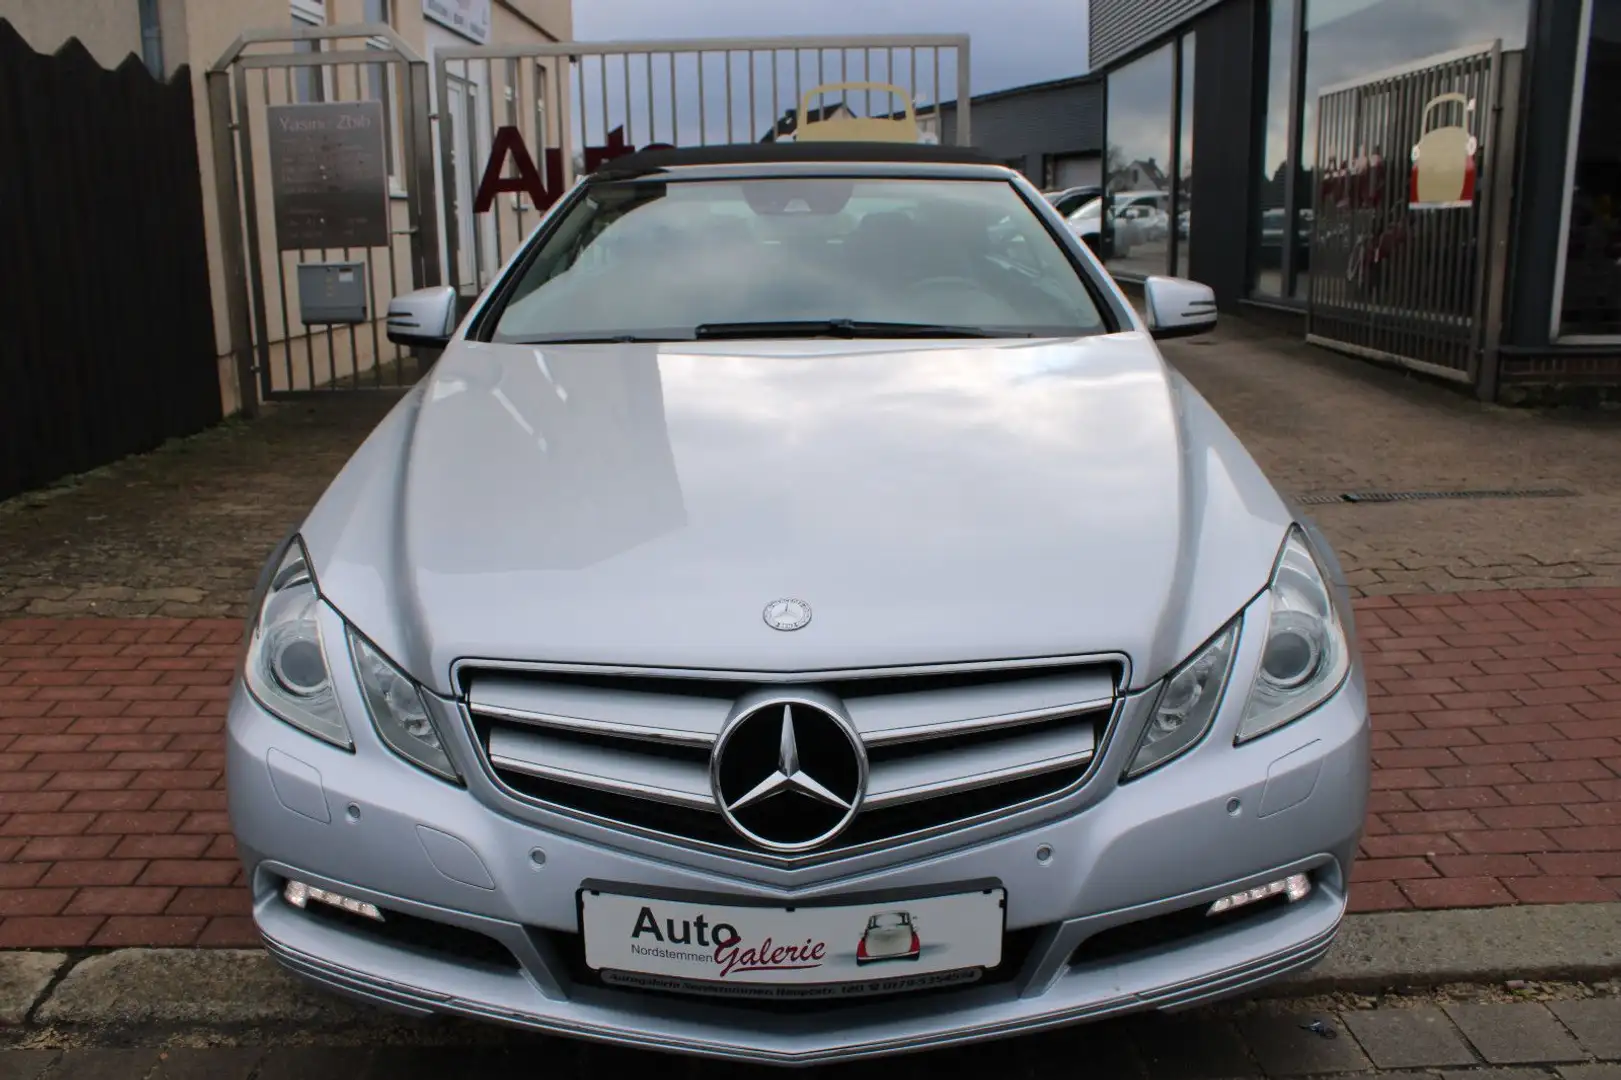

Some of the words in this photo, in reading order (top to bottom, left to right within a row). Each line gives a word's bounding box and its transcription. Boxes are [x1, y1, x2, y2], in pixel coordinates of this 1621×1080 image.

[473, 124, 677, 213] Aut
[630, 905, 739, 949] Auto
[630, 944, 714, 964] Nordstemmen
[713, 937, 826, 977] Galerie
